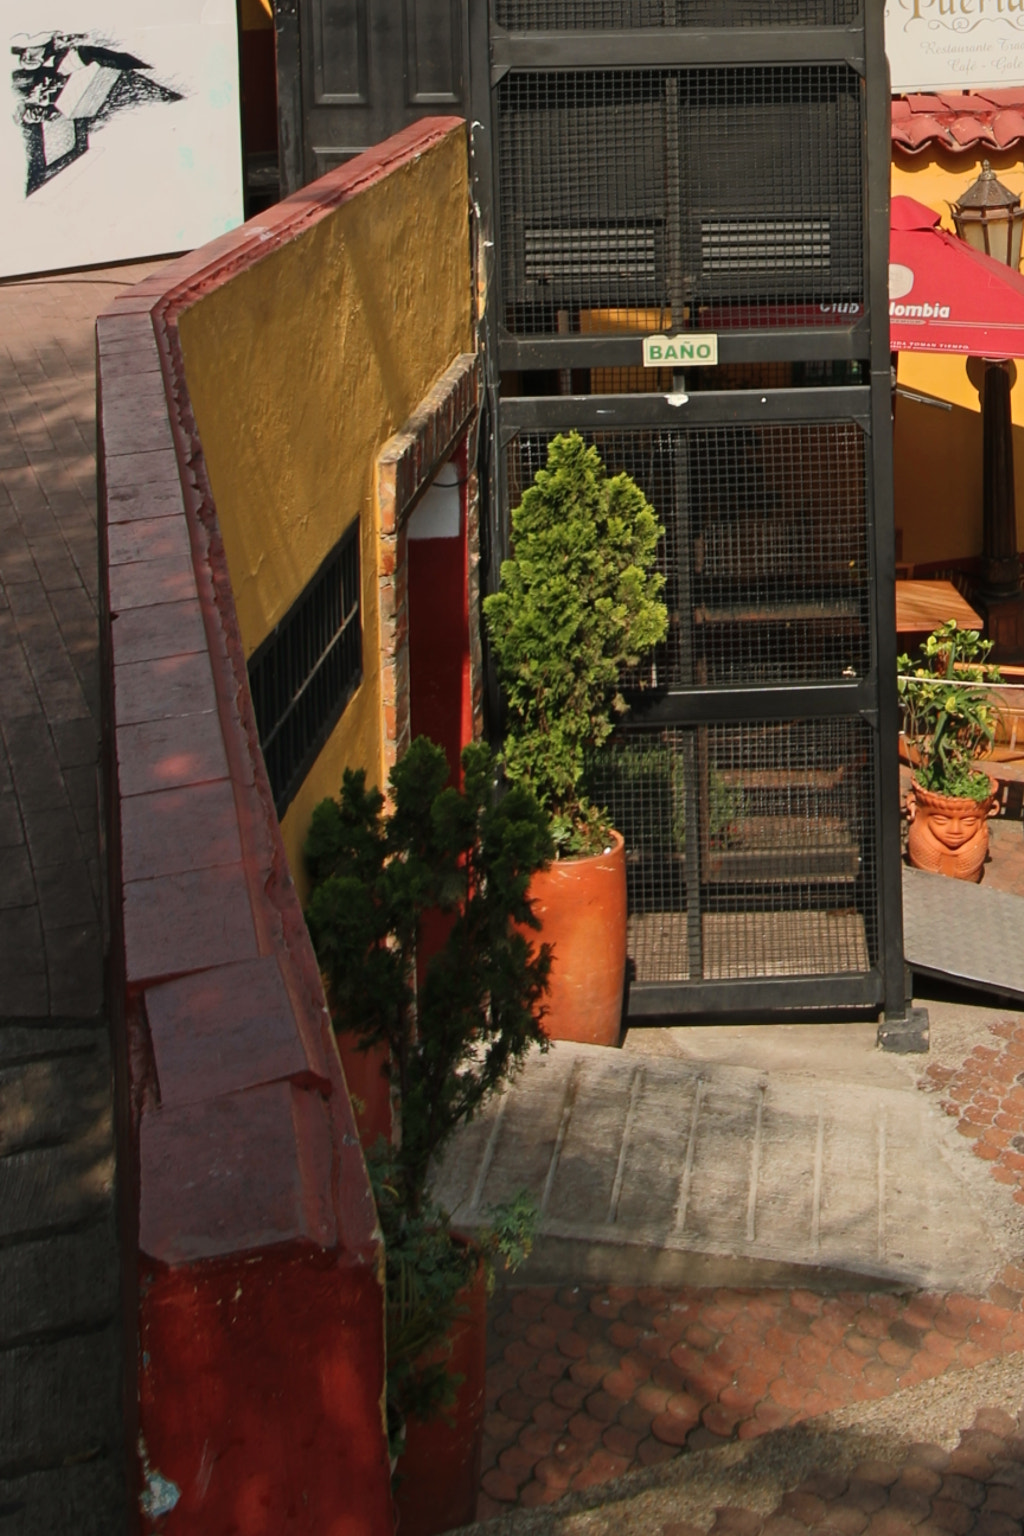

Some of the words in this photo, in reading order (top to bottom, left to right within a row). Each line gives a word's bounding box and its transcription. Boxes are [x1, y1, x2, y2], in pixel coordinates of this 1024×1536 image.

[920, 41, 992, 55] Restaurante
[947, 59, 977, 76] Café
[889, 301, 950, 318] lombia
[650, 341, 711, 359] BAÑO
